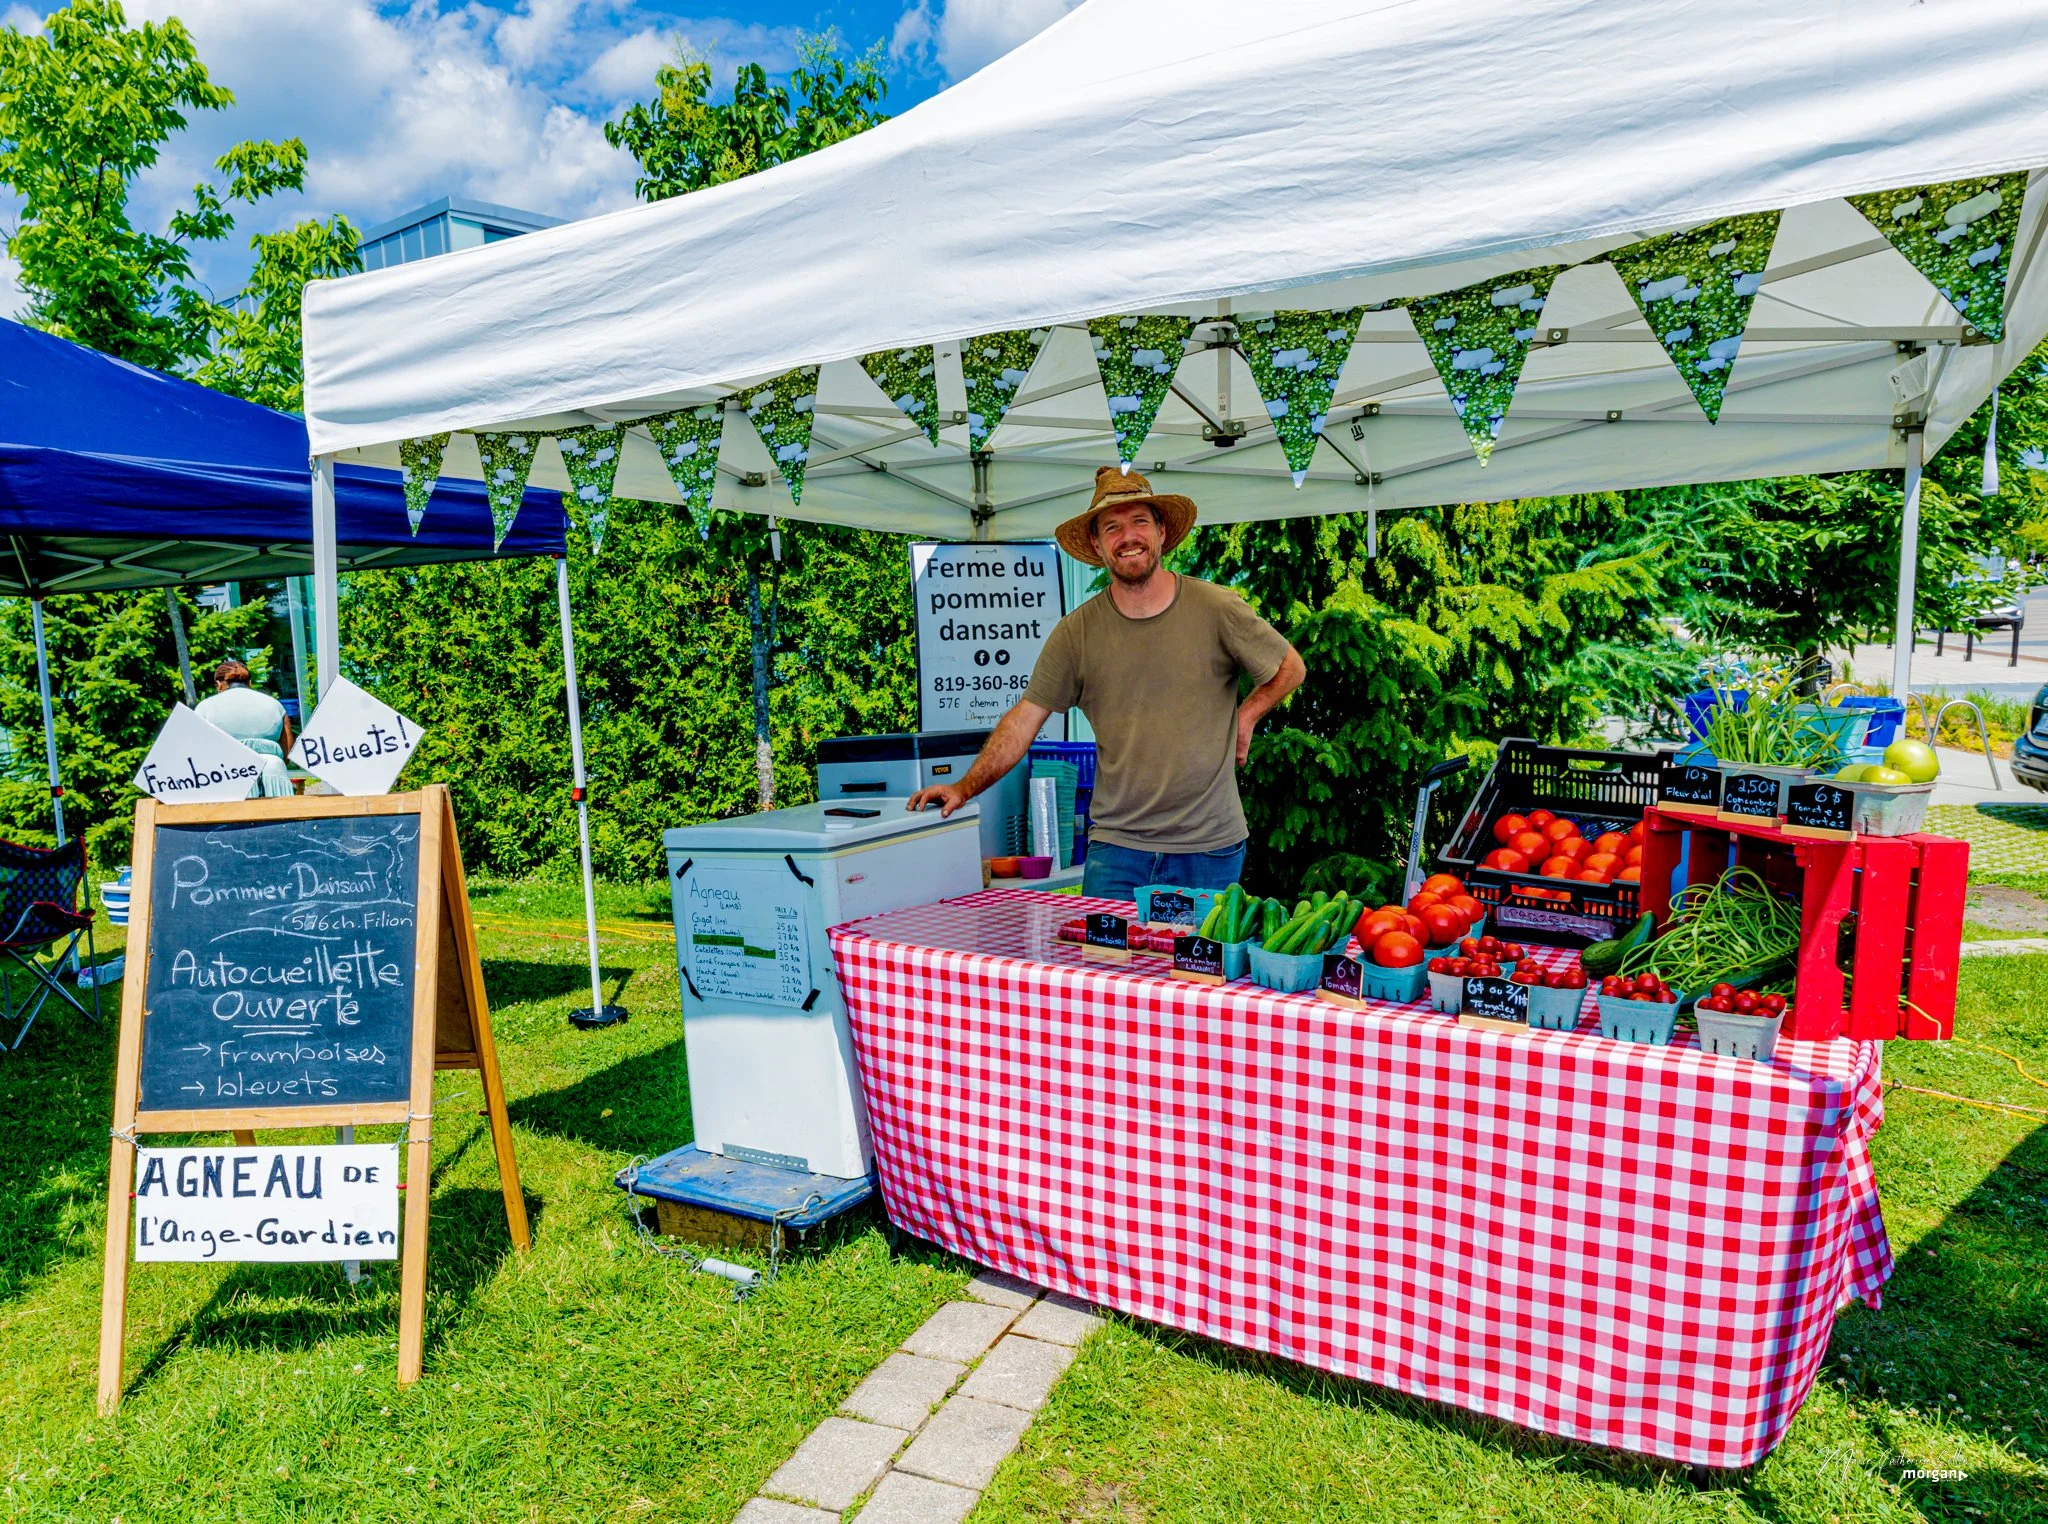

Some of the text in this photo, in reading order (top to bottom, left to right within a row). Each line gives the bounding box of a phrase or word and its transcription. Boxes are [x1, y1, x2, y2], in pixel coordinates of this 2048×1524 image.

[927, 556, 1045, 578] Ferme du
[931, 587, 1045, 614] pommier
[939, 619, 1041, 641] dansant
[939, 697, 960, 708] 576
[970, 695, 998, 708] chemin
[301, 715, 411, 769] Bleuets!
[142, 757, 259, 794] Framboises
[1666, 787, 1690, 798] Fleur
[1727, 794, 1777, 808] Concombres
[1791, 802, 1843, 819] Tomates
[171, 855, 378, 909] Pommier Dansant
[690, 877, 741, 908] Agneau
[1088, 930, 1125, 946] Framboises
[172, 940, 403, 989] Autocueillette
[1175, 953, 1220, 968] Concombres
[1324, 976, 1358, 996] Tomates
[1467, 978, 1485, 995] 6$
[1489, 986, 1503, 995] ou
[213, 985, 361, 1026] Ouverte
[1470, 999, 1515, 1014] Tomates
[220, 1040, 386, 1067] framboises
[218, 1070, 339, 1097] bleuets
[137, 1154, 380, 1199] AGNEAU DE
